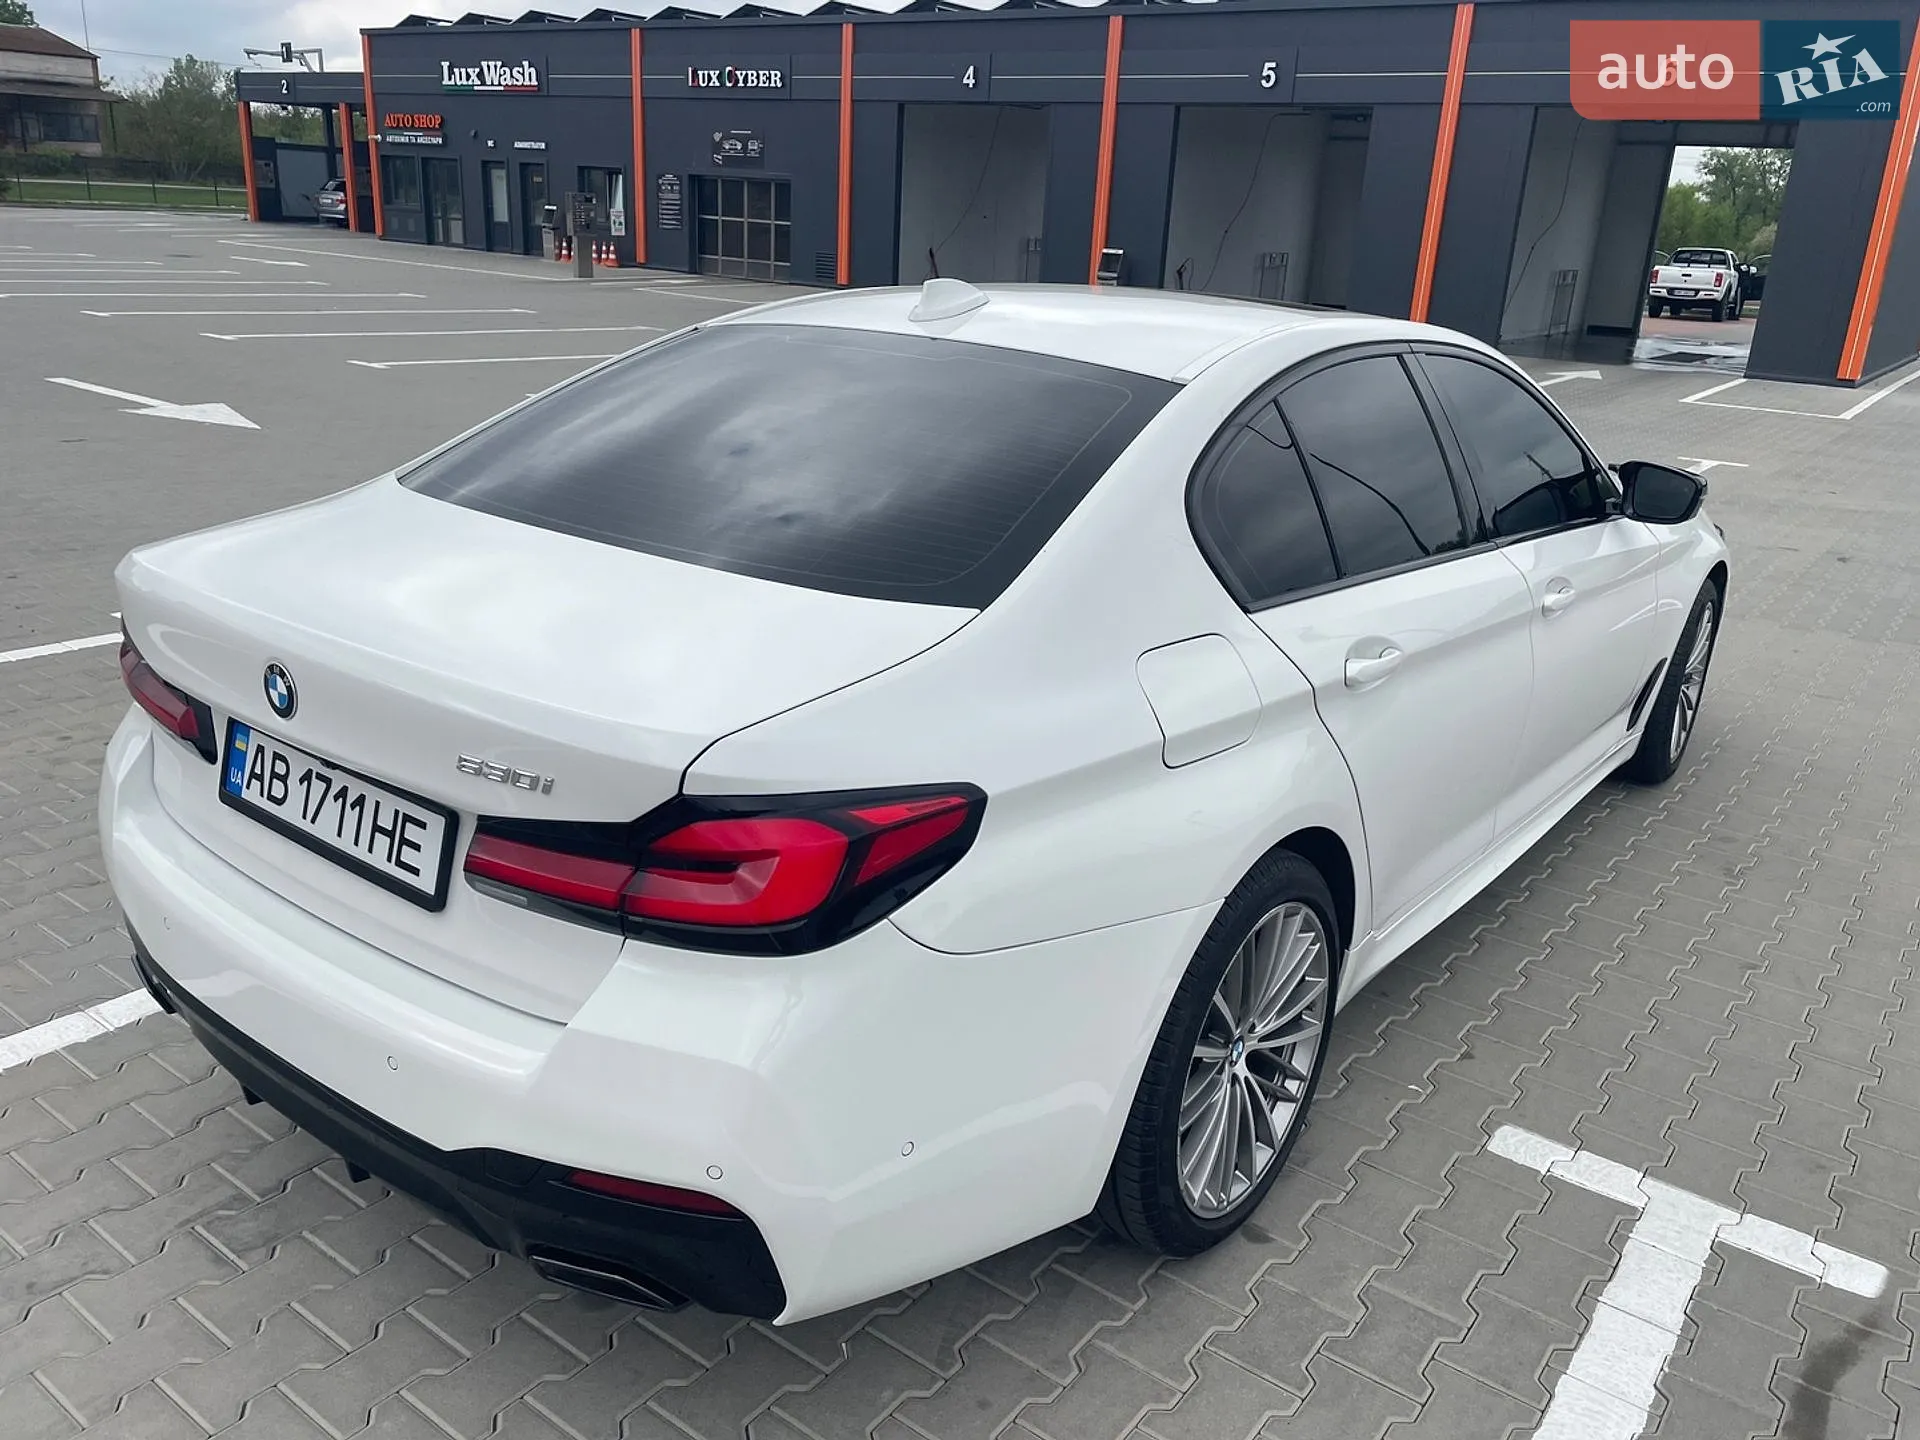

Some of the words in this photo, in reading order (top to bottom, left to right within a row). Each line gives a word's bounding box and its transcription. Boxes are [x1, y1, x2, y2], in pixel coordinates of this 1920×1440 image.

[441, 61, 481, 86] Lux
[480, 60, 538, 86] Wash
[688, 66, 721, 88] LUX
[723, 65, 783, 88] CYBER
[962, 65, 976, 88] 4
[1261, 62, 1278, 88] 5
[281, 79, 289, 94] 2
[384, 113, 412, 128] AUTO
[413, 114, 442, 129] SHOP
[230, 767, 242, 786] UA
[456, 753, 555, 796] 530i
[245, 743, 291, 807] AB
[298, 767, 366, 848] 1711
[367, 800, 428, 878] HE
